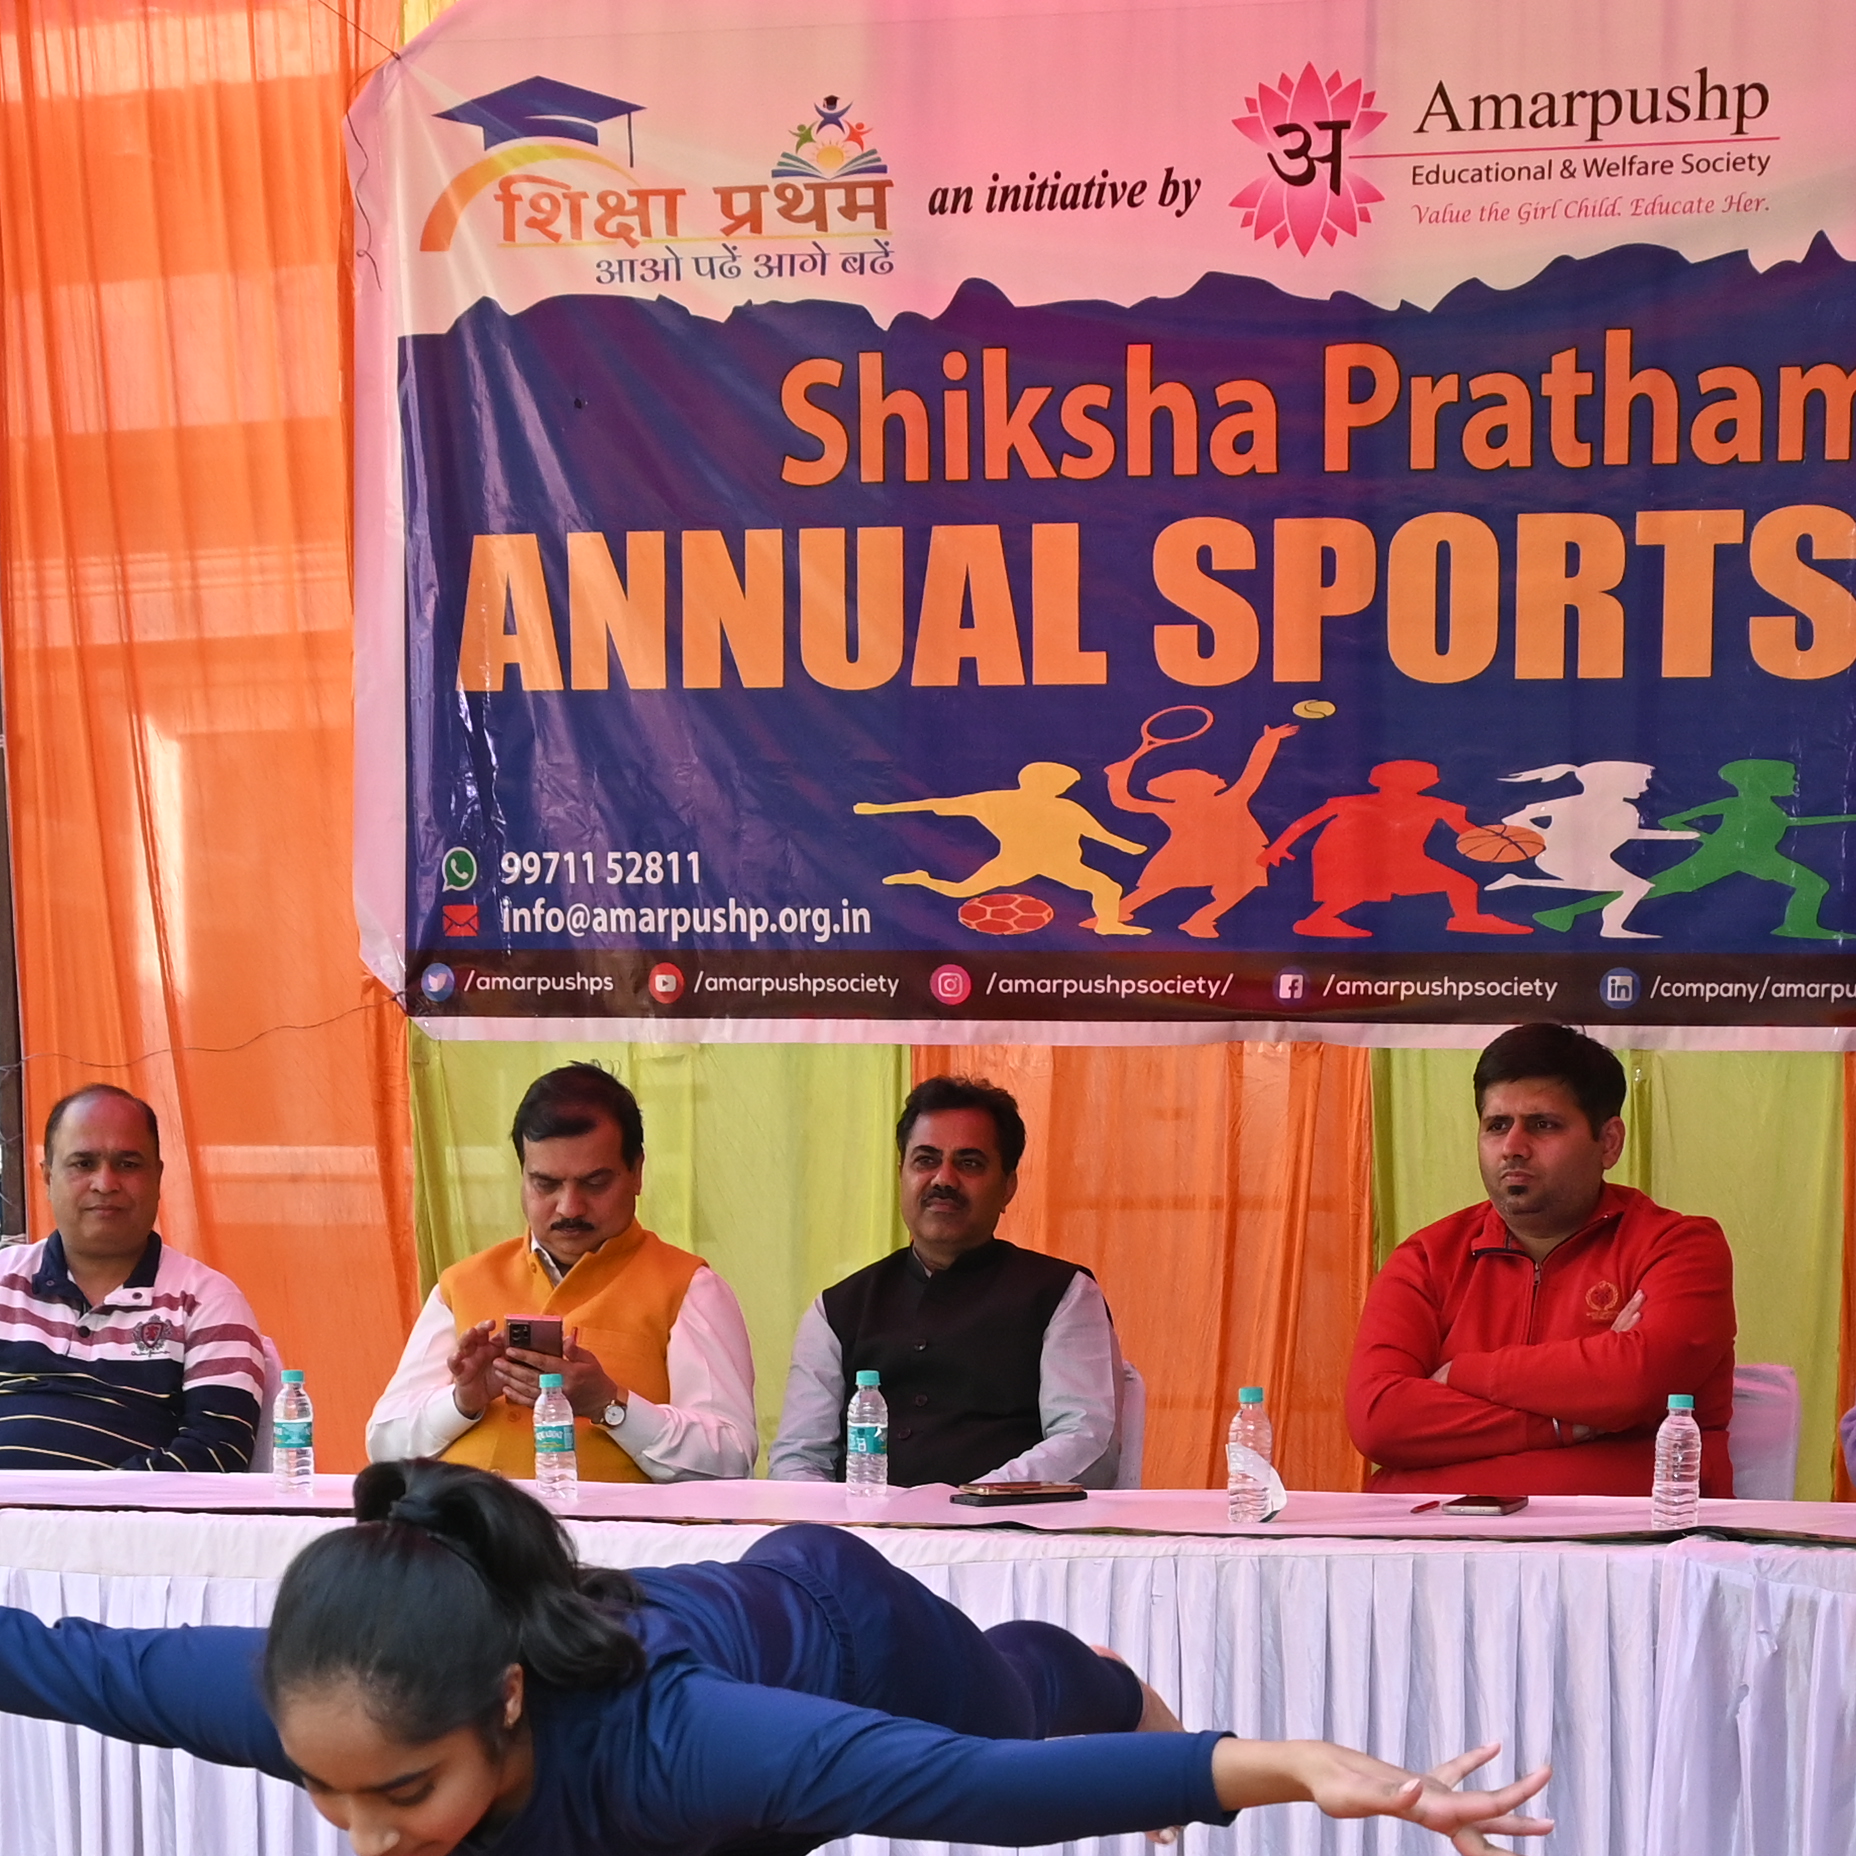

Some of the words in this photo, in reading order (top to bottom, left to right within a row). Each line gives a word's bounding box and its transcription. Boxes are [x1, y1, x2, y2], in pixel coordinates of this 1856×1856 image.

[1413, 67, 1770, 143] Amarpushp
[1412, 158, 1553, 186] Educational
[1560, 157, 1577, 180] &
[1583, 154, 1674, 179] Welfare
[1681, 151, 1771, 178] Society
[493, 173, 687, 249] शिक्षा
[713, 178, 895, 238] प्रथम
[928, 185, 974, 216] an
[985, 169, 1148, 214] initiative
[1158, 166, 1202, 218] by
[1411, 203, 1471, 225] Value
[1479, 201, 1511, 223] the
[1517, 197, 1559, 225] Girl
[1563, 195, 1622, 220] Child.
[1630, 193, 1716, 217] Educate
[1723, 191, 1770, 214] Her.
[780, 343, 1279, 488] Shiksha
[457, 521, 1108, 693] ANNUAL
[502, 897, 872, 943] info@amarpushp.org.in
[464, 969, 615, 996] /amarpushps
[693, 970, 901, 998] /amarpushpsociety
[985, 971, 1235, 999] /amarpushpsociety/
[1322, 973, 1559, 1001] /amarpushpsociety
